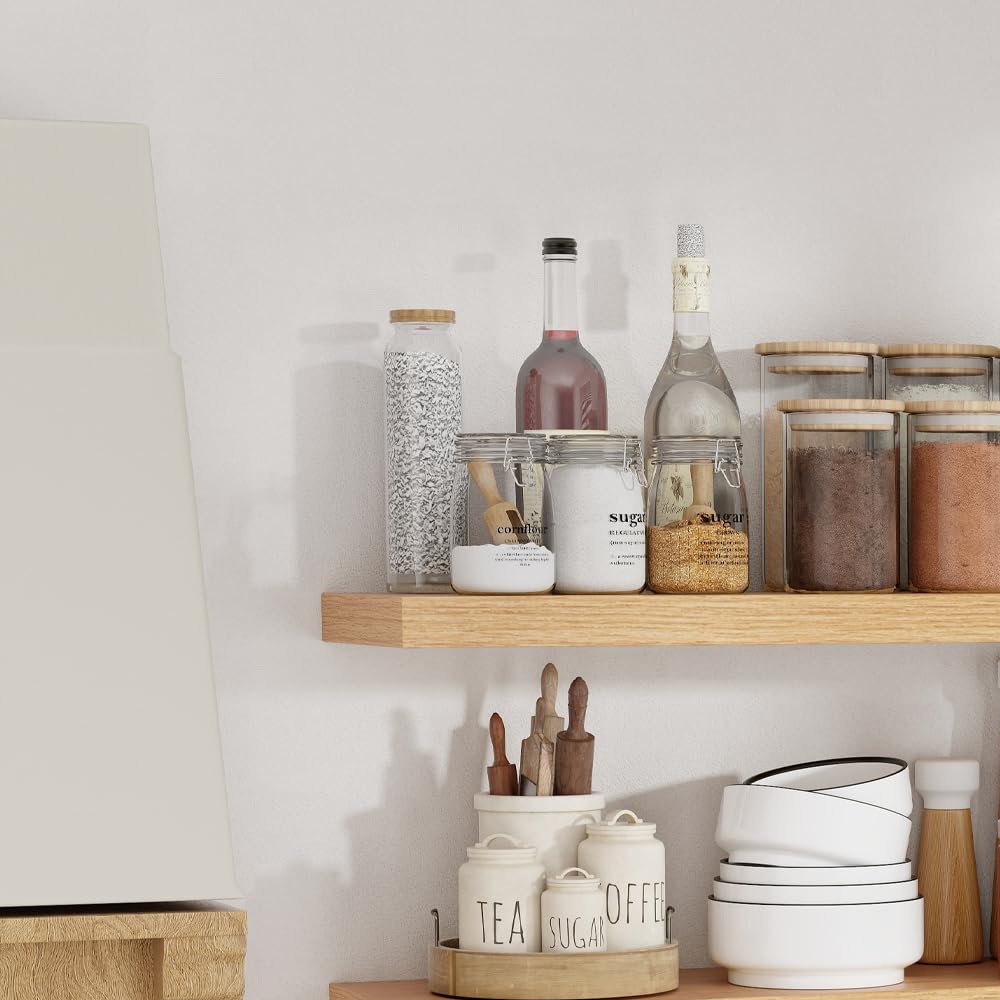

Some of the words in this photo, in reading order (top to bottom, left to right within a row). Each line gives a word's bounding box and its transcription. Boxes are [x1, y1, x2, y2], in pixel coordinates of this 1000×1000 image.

[609, 512, 646, 528] sugar
[700, 512, 744, 528] sugar
[600, 881, 665, 924] OFFEE
[476, 900, 525, 946] TEA
[549, 916, 604, 950] SUGAR
